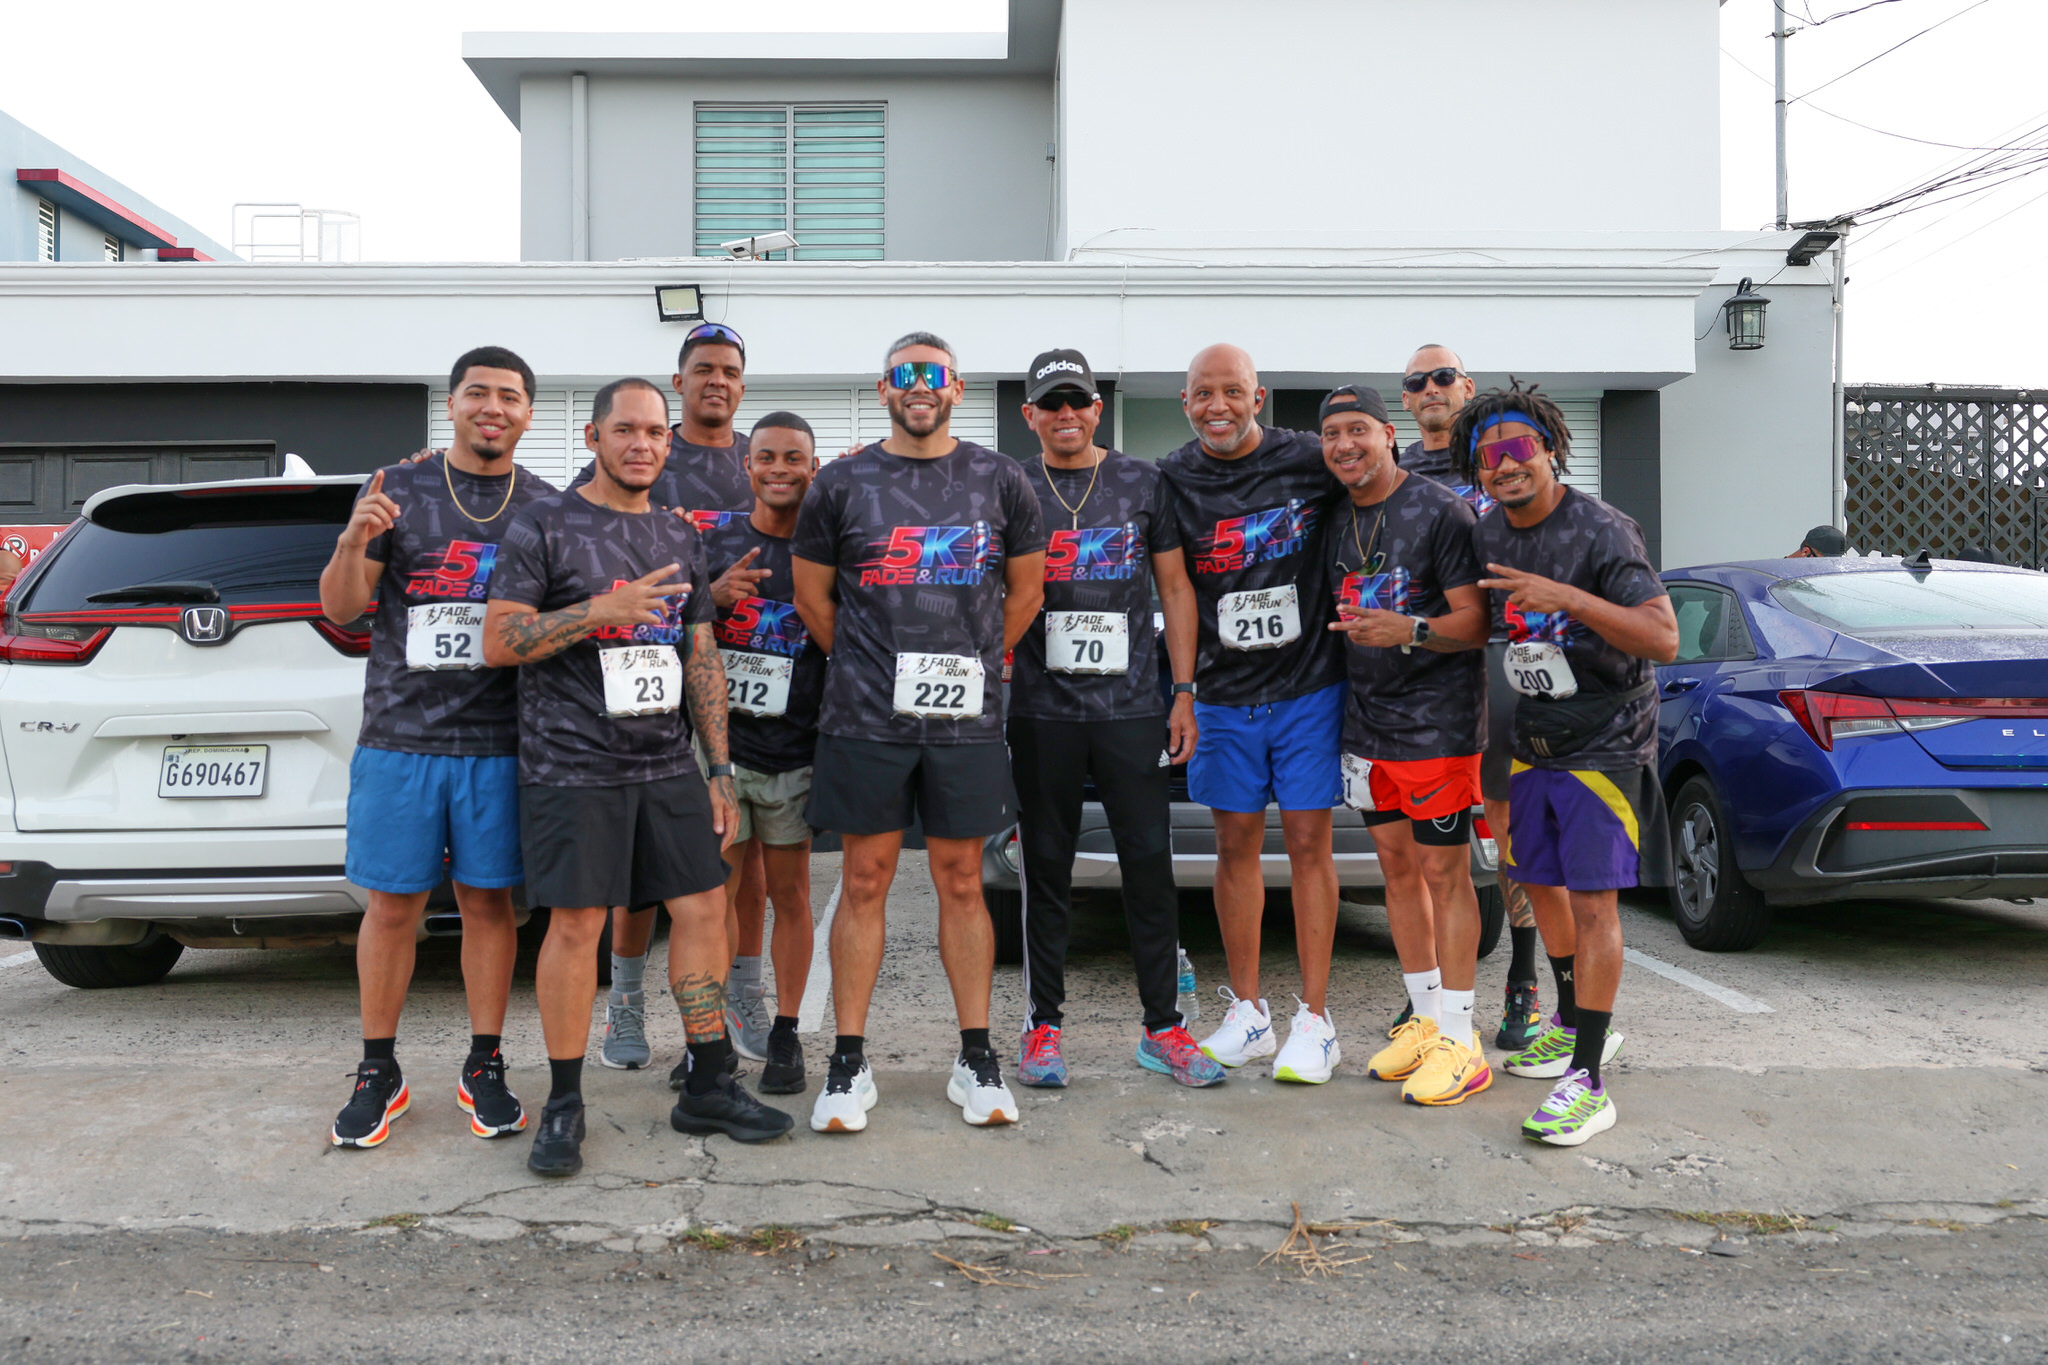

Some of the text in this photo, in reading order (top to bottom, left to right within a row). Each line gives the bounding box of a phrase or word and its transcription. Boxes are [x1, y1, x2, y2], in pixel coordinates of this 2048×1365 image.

[1036, 360, 1084, 379] adidas
[1210, 506, 1287, 558] 5K
[880, 526, 973, 568] 5K
[1045, 527, 1124, 567] 5K
[1196, 554, 1243, 574] FADE
[1244, 552, 1256, 568] &
[859, 568, 917, 587] FADE
[916, 568, 933, 585] &
[1044, 567, 1074, 582] DE
[1073, 566, 1088, 580] &
[404, 579, 486, 599] FADE &
[1244, 591, 1271, 603] FADE
[440, 606, 472, 617] FADE
[1258, 600, 1281, 610] RUN
[455, 616, 483, 626] RUN
[724, 595, 797, 635] 5K
[1075, 614, 1105, 625] FADE
[584, 624, 636, 640] ADE
[633, 624, 651, 640] &
[1090, 624, 1114, 633] RUN
[1235, 614, 1284, 642] 216
[434, 632, 471, 659] 52
[749, 635, 764, 648] &
[635, 649, 661, 660] FADE
[1072, 639, 1104, 663] 70
[1522, 652, 1544, 664] RUN
[649, 659, 669, 669] RUN
[738, 654, 767, 667] FADE
[931, 657, 961, 668] FADE
[748, 665, 774, 677] RUN
[945, 668, 969, 677] RUN
[1514, 668, 1554, 691] 200
[634, 675, 665, 703] 23
[727, 677, 769, 707] 212
[914, 682, 966, 708] 222
[20, 721, 80, 733] CR-V
[166, 761, 261, 787] G690467
